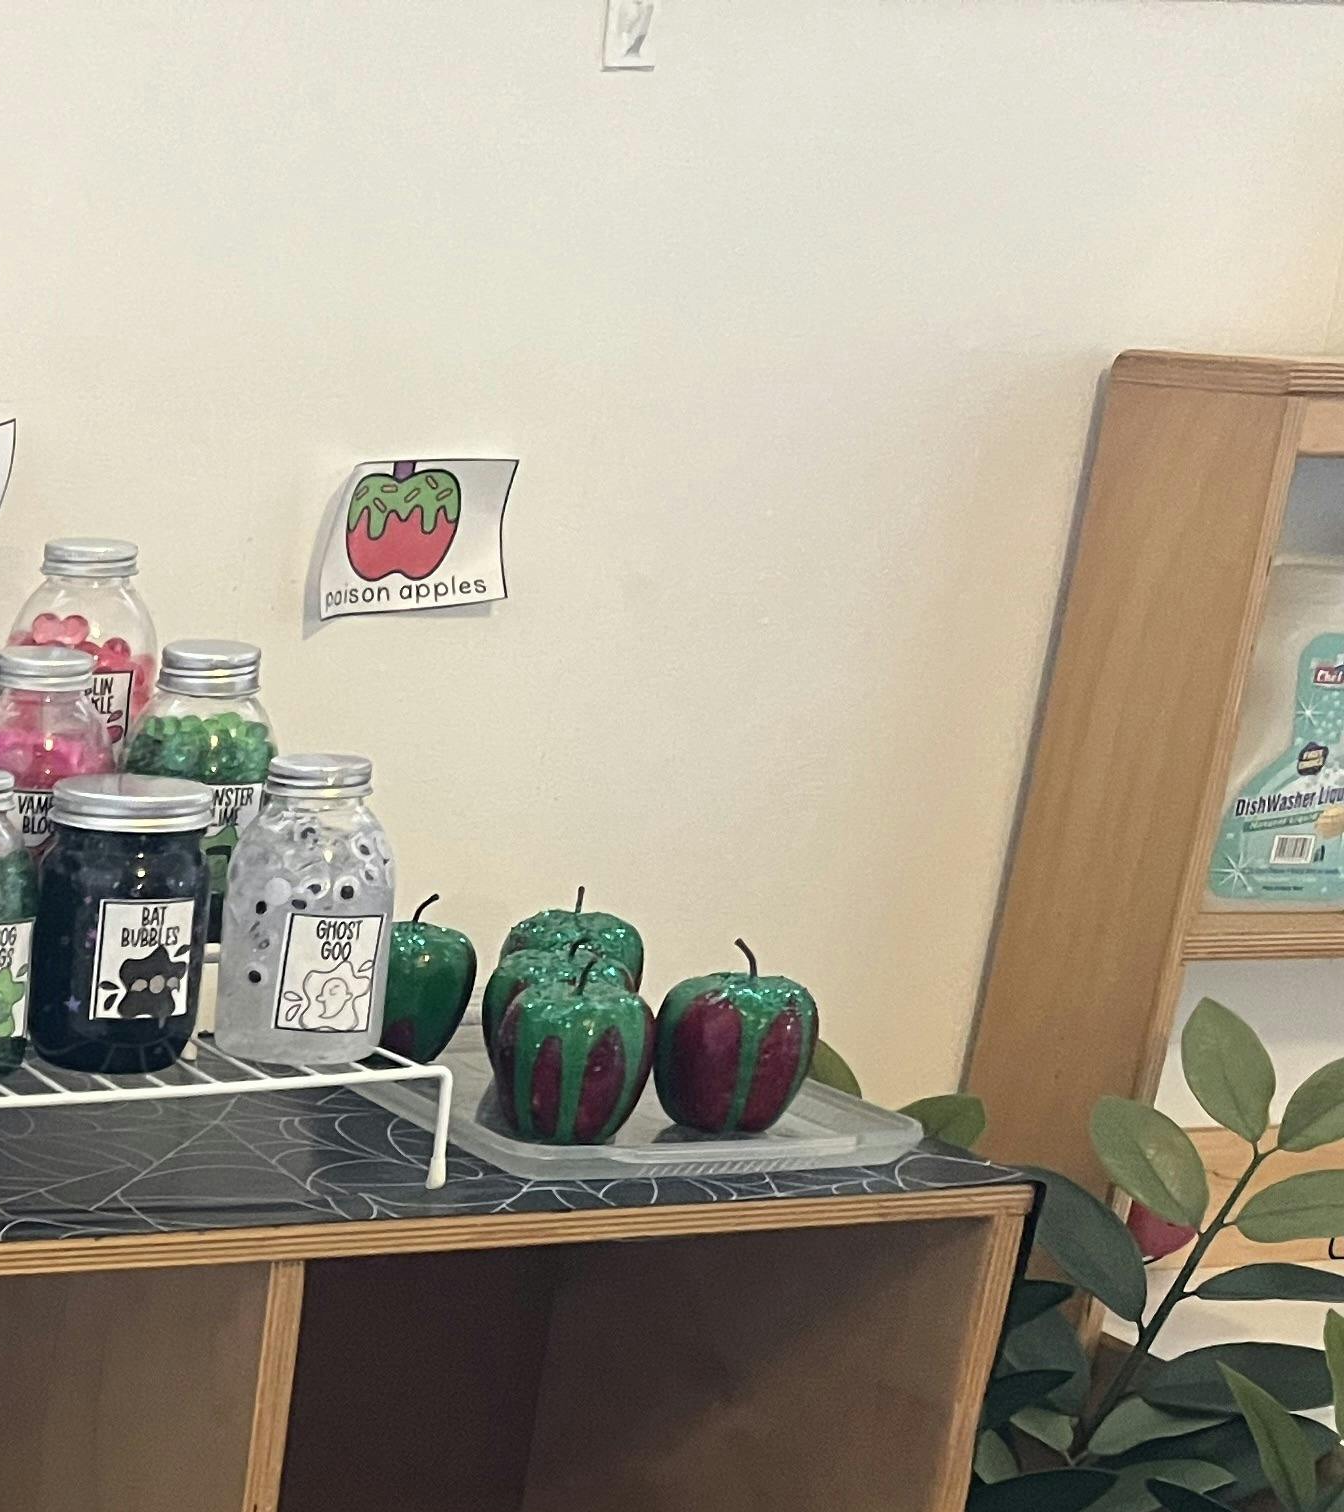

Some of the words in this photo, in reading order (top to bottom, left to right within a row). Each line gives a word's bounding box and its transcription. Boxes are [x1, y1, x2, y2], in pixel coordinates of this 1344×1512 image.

[325, 583, 390, 612] poison
[399, 576, 487, 603] apples
[1235, 792, 1316, 816] DishWasher
[141, 906, 167, 926] BAT
[121, 926, 180, 948] BUBBLES
[316, 919, 363, 940] GHOST
[321, 941, 352, 960] GOO
